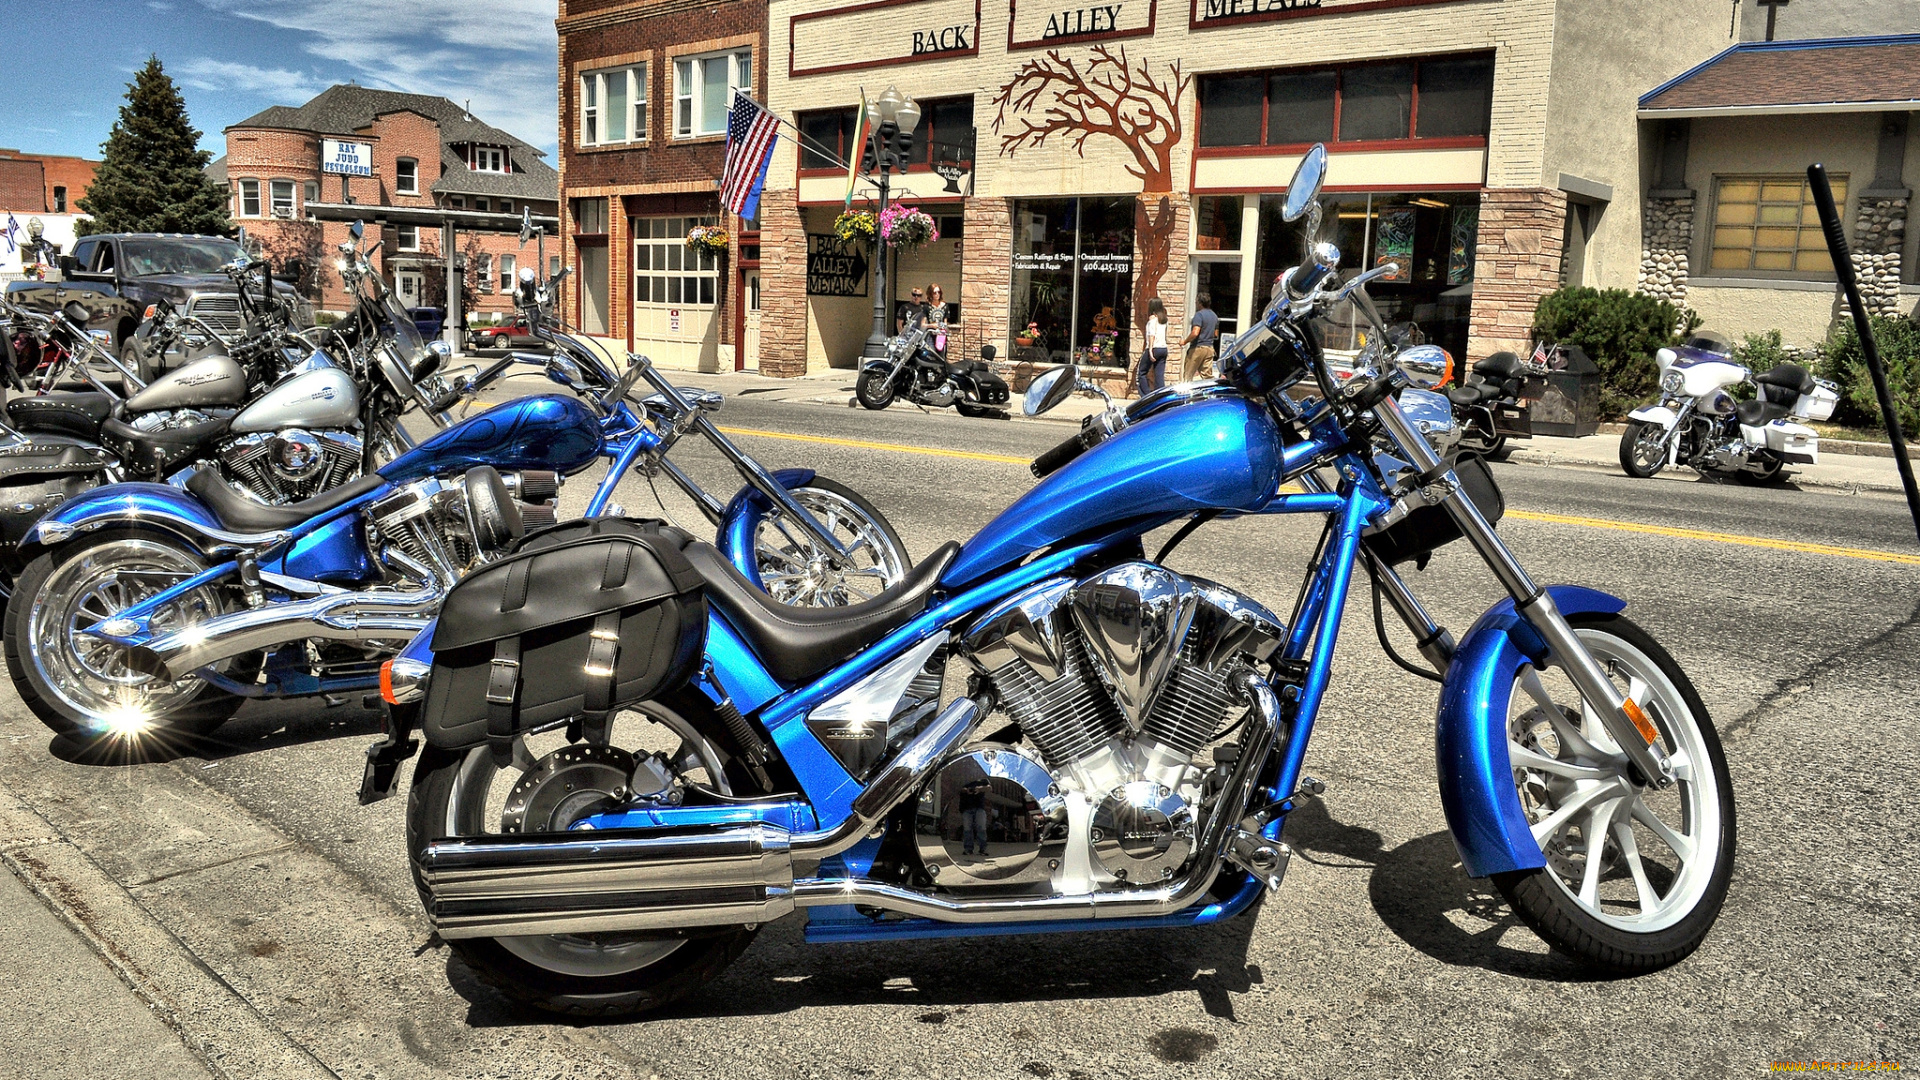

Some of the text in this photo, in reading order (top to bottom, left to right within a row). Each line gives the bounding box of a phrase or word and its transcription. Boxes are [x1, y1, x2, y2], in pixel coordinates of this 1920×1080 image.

[912, 25, 969, 55] BACK
[1042, 5, 1121, 40] ALLEY
[338, 144, 356, 153] RAY
[336, 154, 358, 164] JUDD
[325, 162, 370, 174] PETROLEUM
[816, 236, 849, 256] BACK
[1060, 252, 1074, 262] Signs
[810, 256, 854, 275] ALLEY
[1083, 260, 1128, 273] 406.425.1533
[808, 274, 855, 295] METALS
